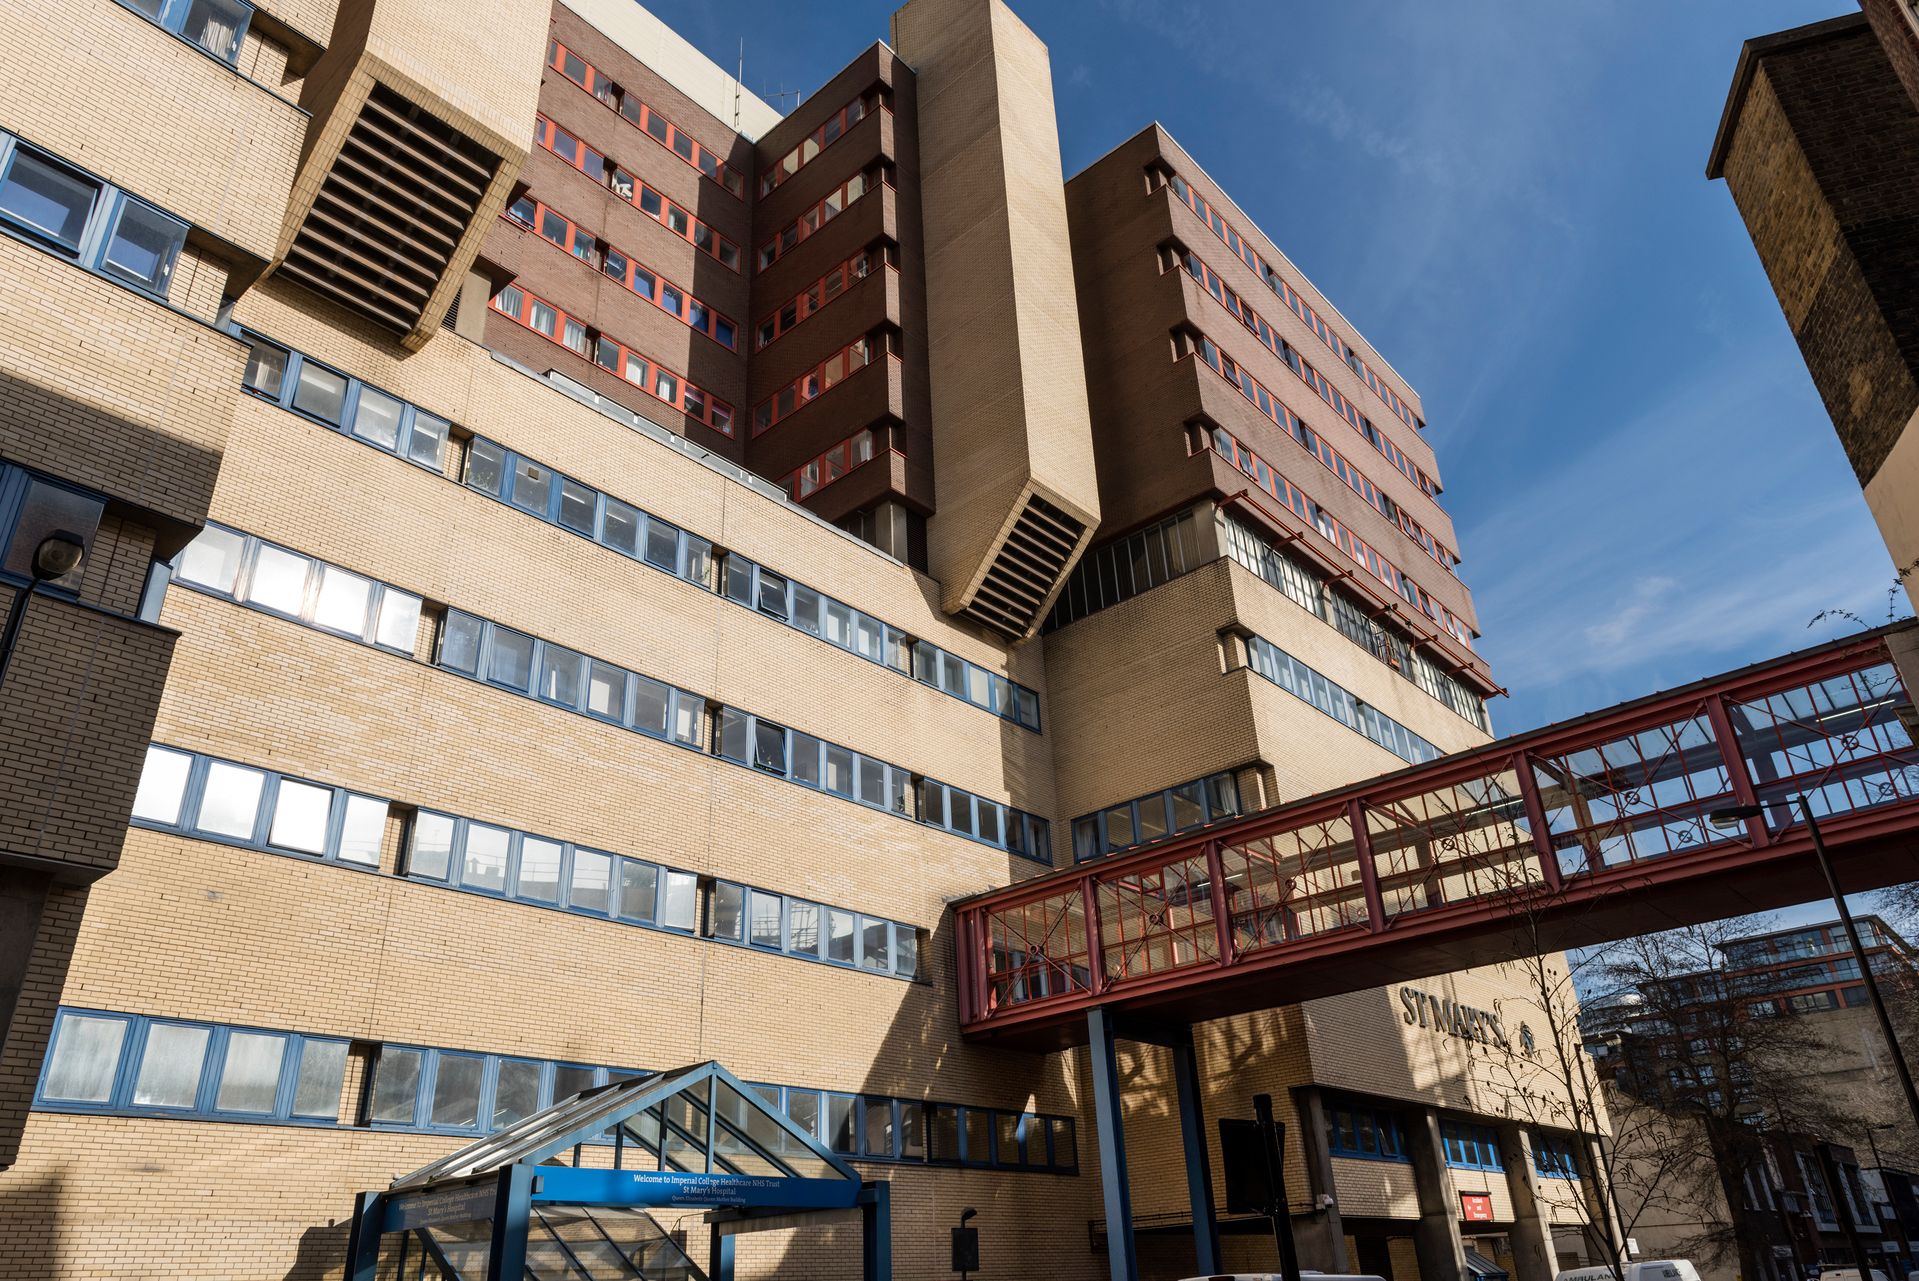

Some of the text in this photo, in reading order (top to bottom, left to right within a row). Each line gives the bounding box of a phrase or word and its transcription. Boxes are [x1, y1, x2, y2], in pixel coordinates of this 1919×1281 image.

[1400, 986, 1426, 1028] ST
[633, 1174, 662, 1184] Welcome
[663, 1176, 671, 1184] to
[671, 1175, 698, 1186] Imperial
[720, 1178, 751, 1186] Healthcare
[752, 1179, 765, 1187] NHS
[765, 1179, 780, 1188] Trust
[683, 1185, 736, 1196] St Mary's Hospital
